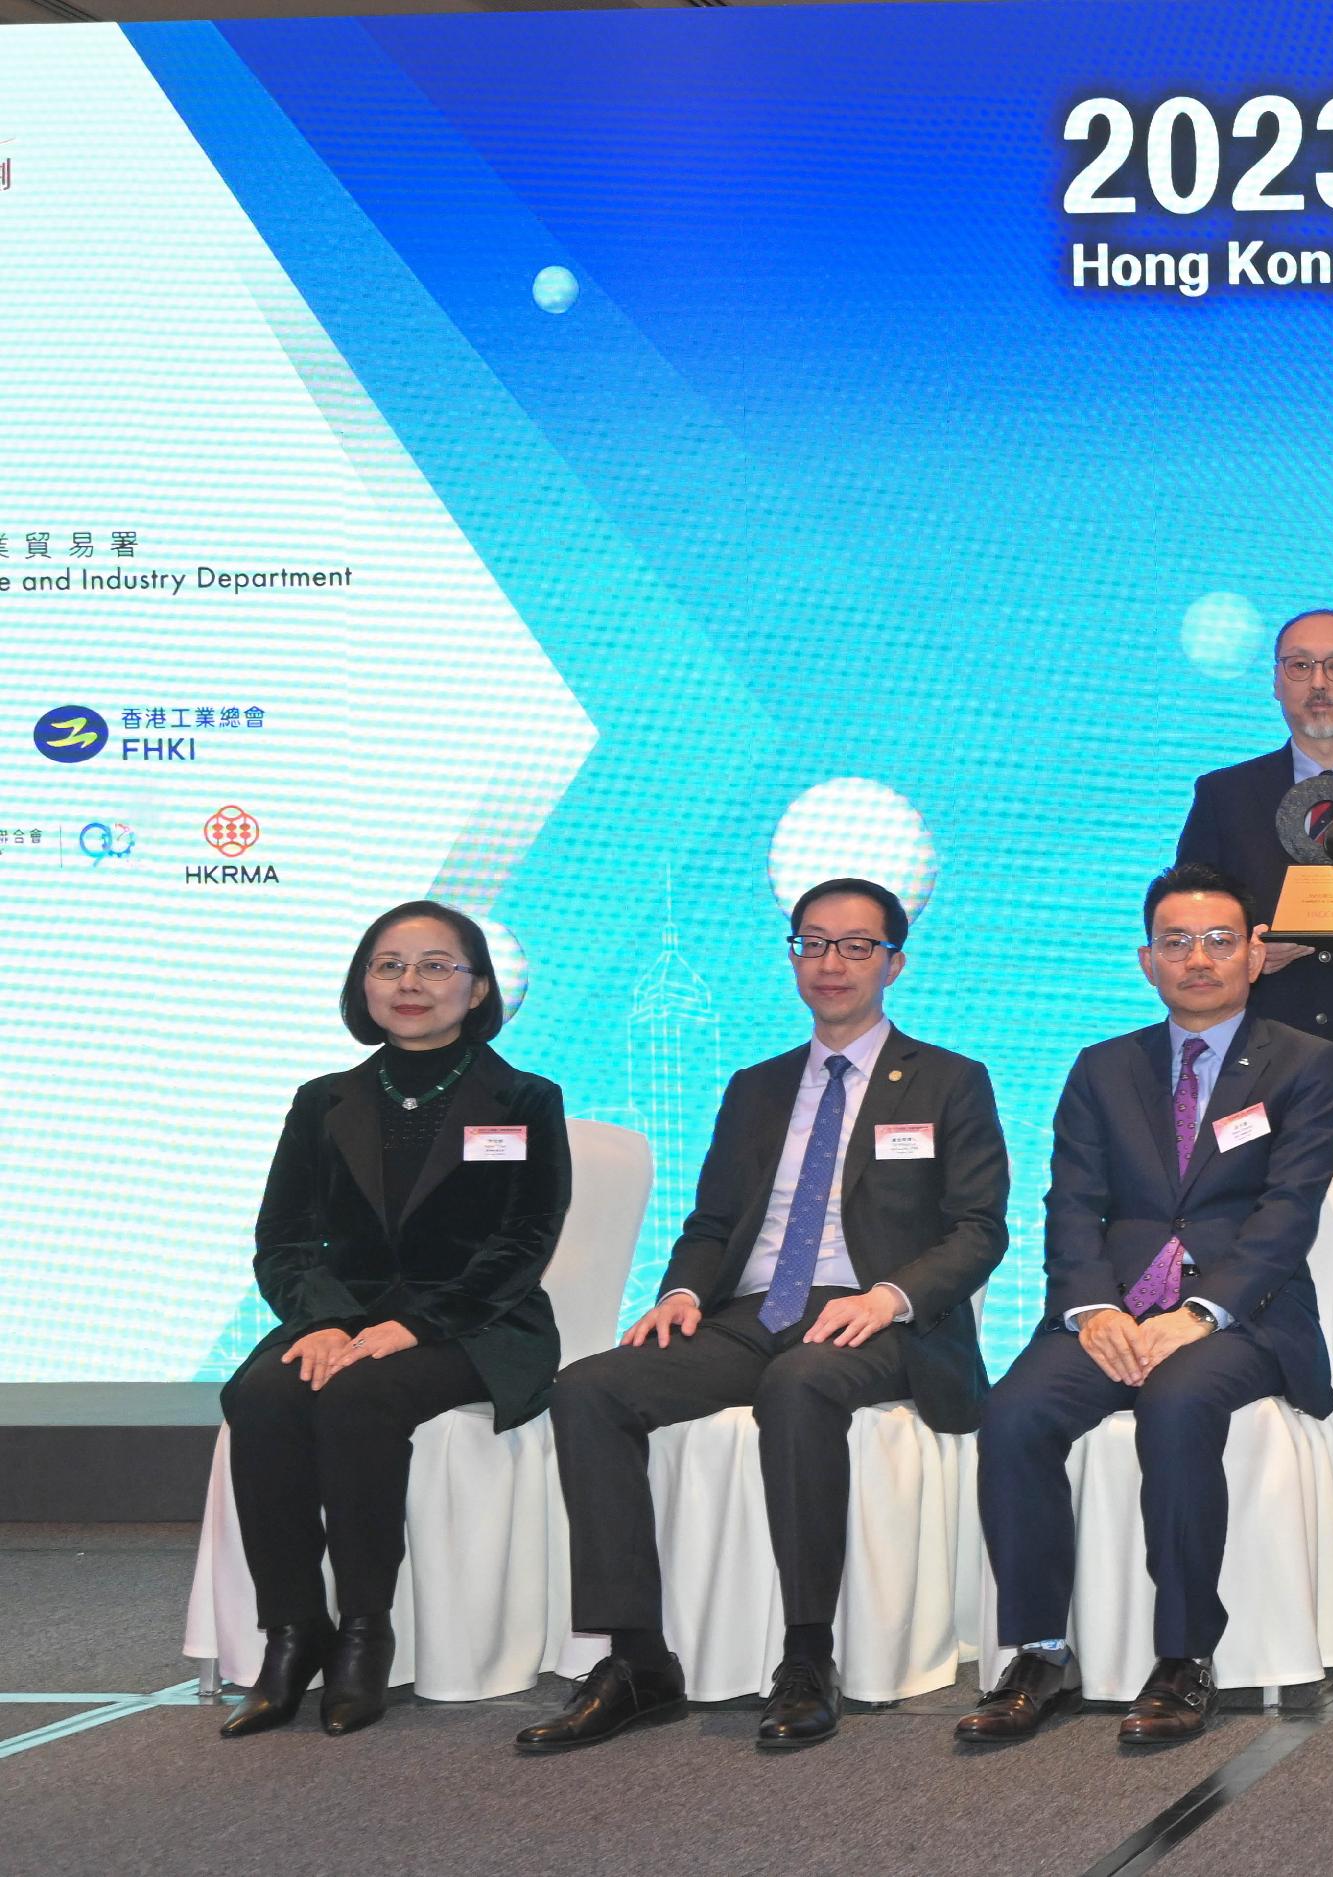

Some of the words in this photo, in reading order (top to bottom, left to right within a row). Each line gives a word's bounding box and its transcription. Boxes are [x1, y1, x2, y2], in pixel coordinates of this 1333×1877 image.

[1073, 243, 1209, 297] Hong
[23, 567, 70, 592] and
[83, 566, 186, 596] Industry
[197, 566, 352, 595] Department
[121, 706, 265, 729] 香港工業總會
[122, 738, 195, 761] FHKI
[186, 865, 280, 884] HKRMA
